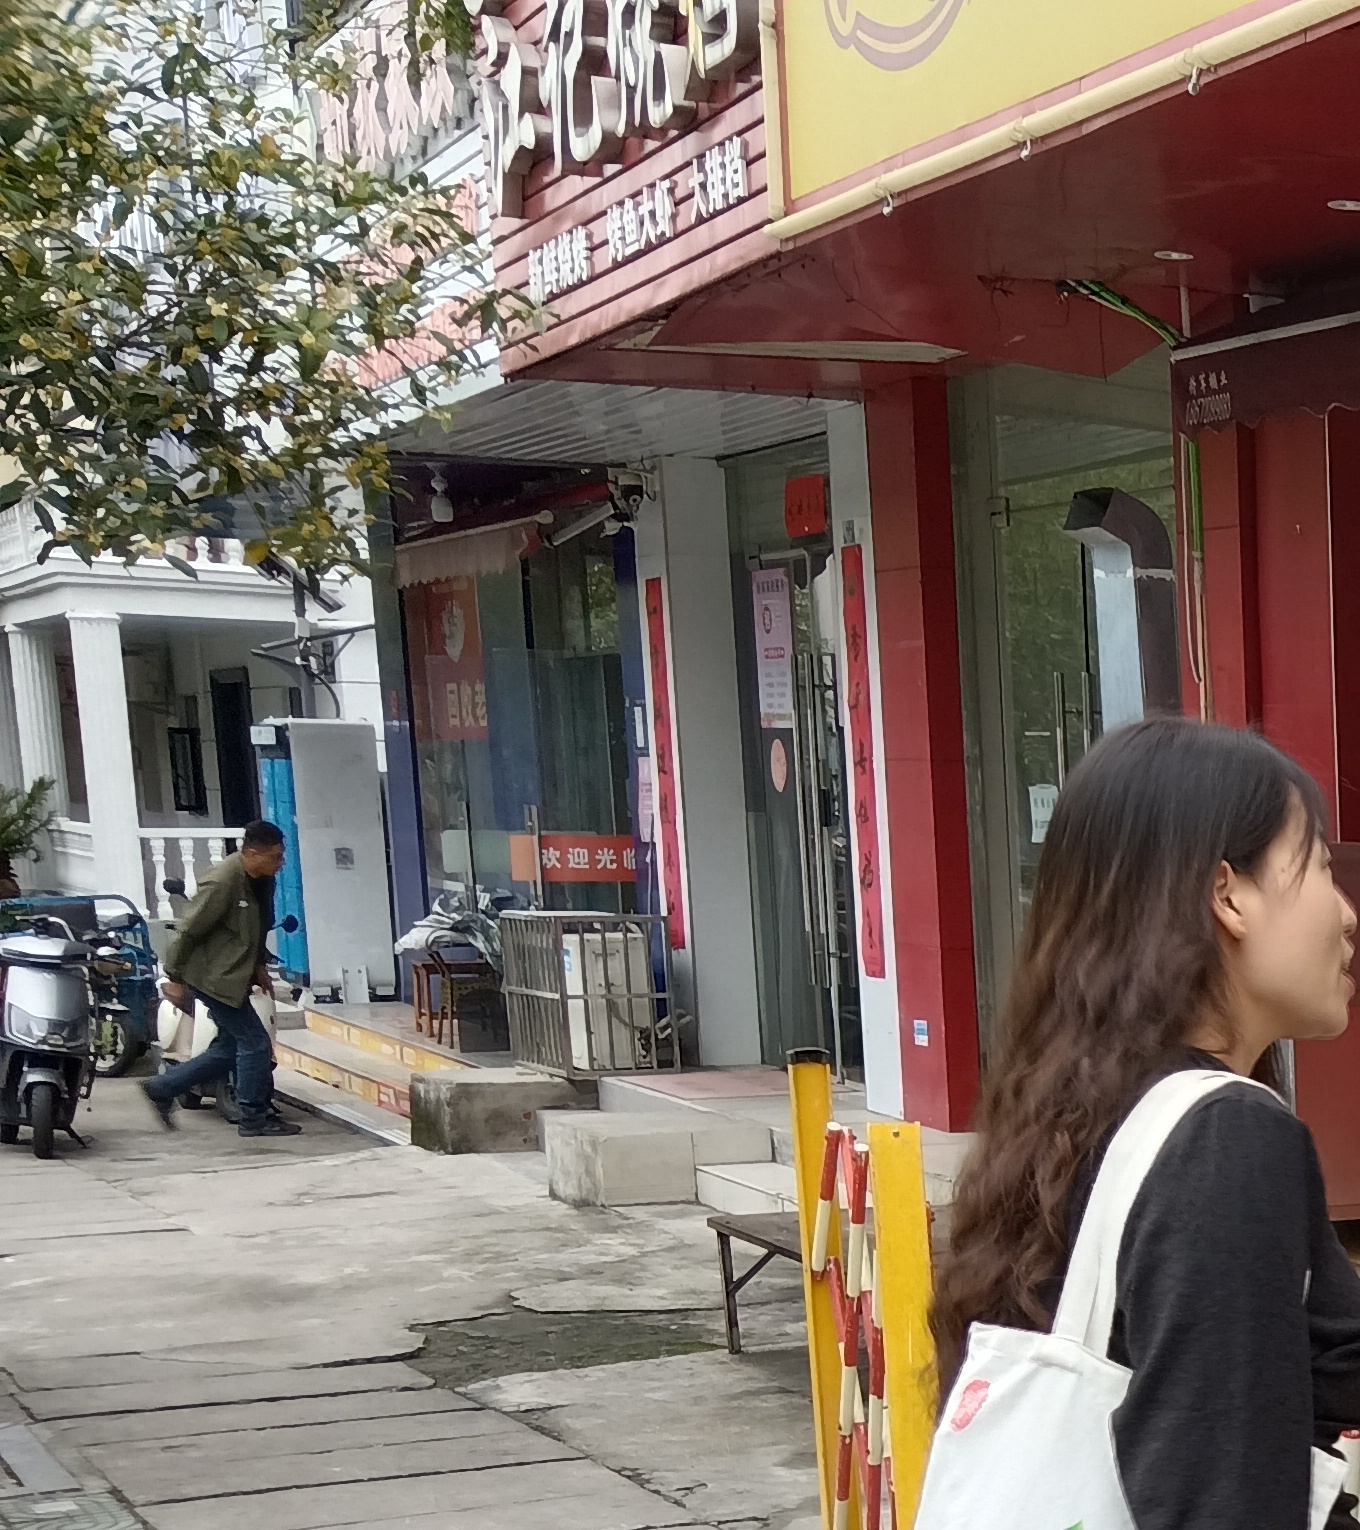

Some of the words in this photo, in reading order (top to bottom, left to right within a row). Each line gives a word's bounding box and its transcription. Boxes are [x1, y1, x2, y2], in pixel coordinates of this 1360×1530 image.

[606, 178, 676, 266] 烤鱼大虾
[688, 135, 749, 224] 大排档
